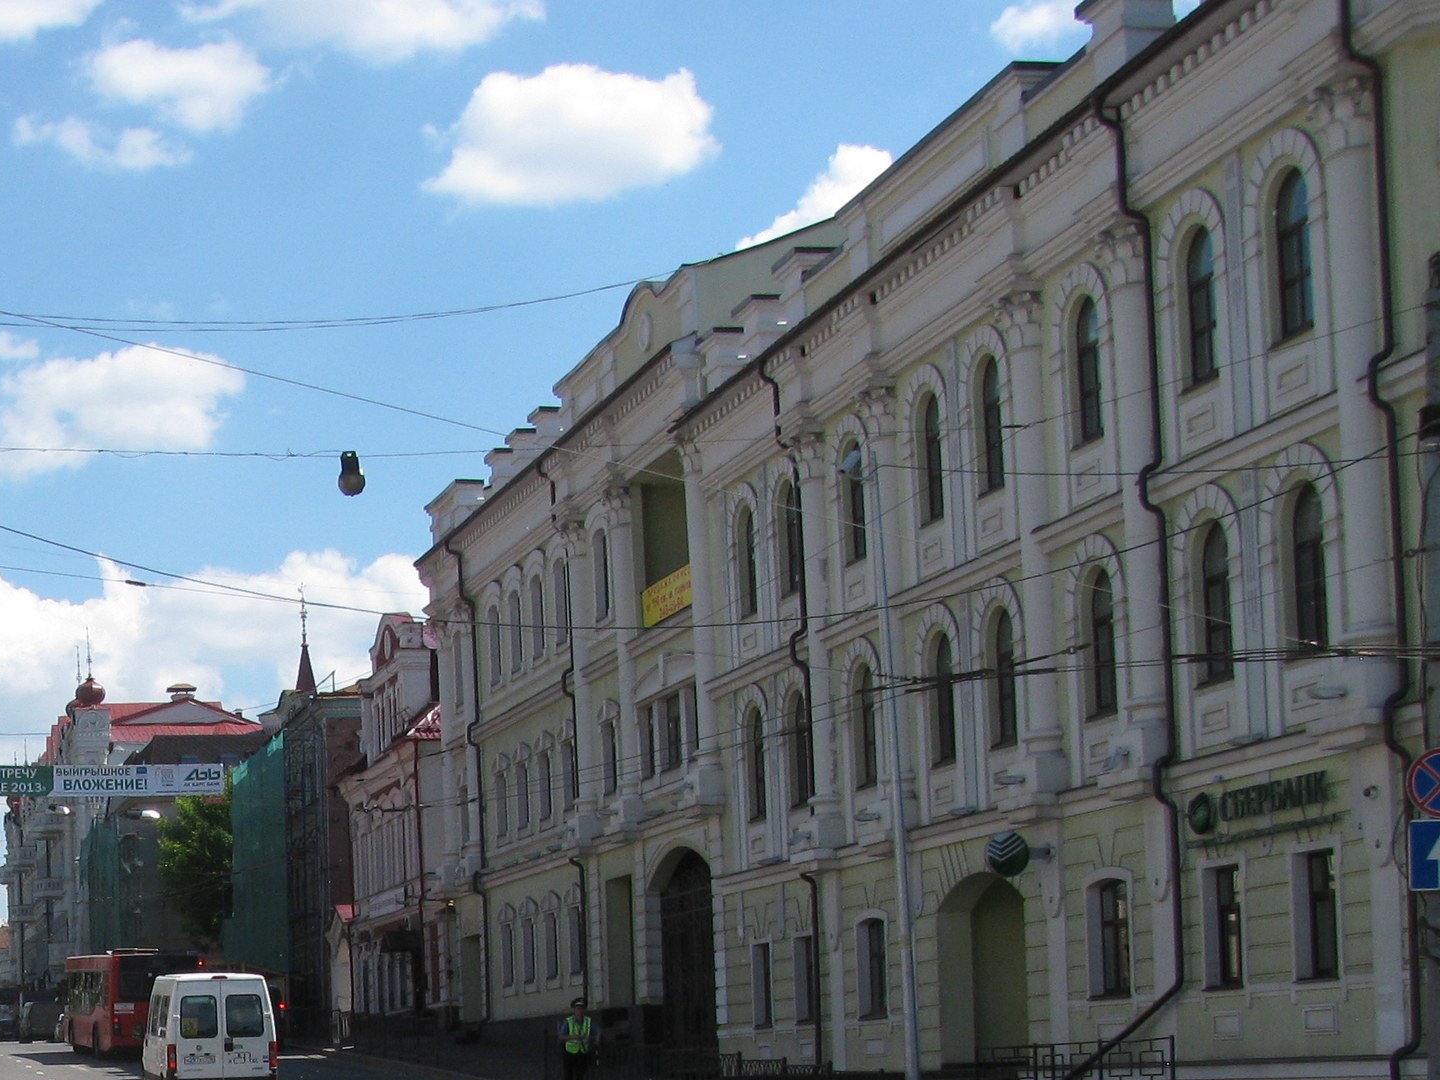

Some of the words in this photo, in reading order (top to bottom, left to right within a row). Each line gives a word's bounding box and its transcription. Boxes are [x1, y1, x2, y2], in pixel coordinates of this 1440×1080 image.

[56, 767, 130, 776] ВЫИГРЫШНОЕ
[63, 778, 148, 791] ВЛОЖЕНИЕ!
[1219, 770, 1328, 821] СБЕРБАНК
